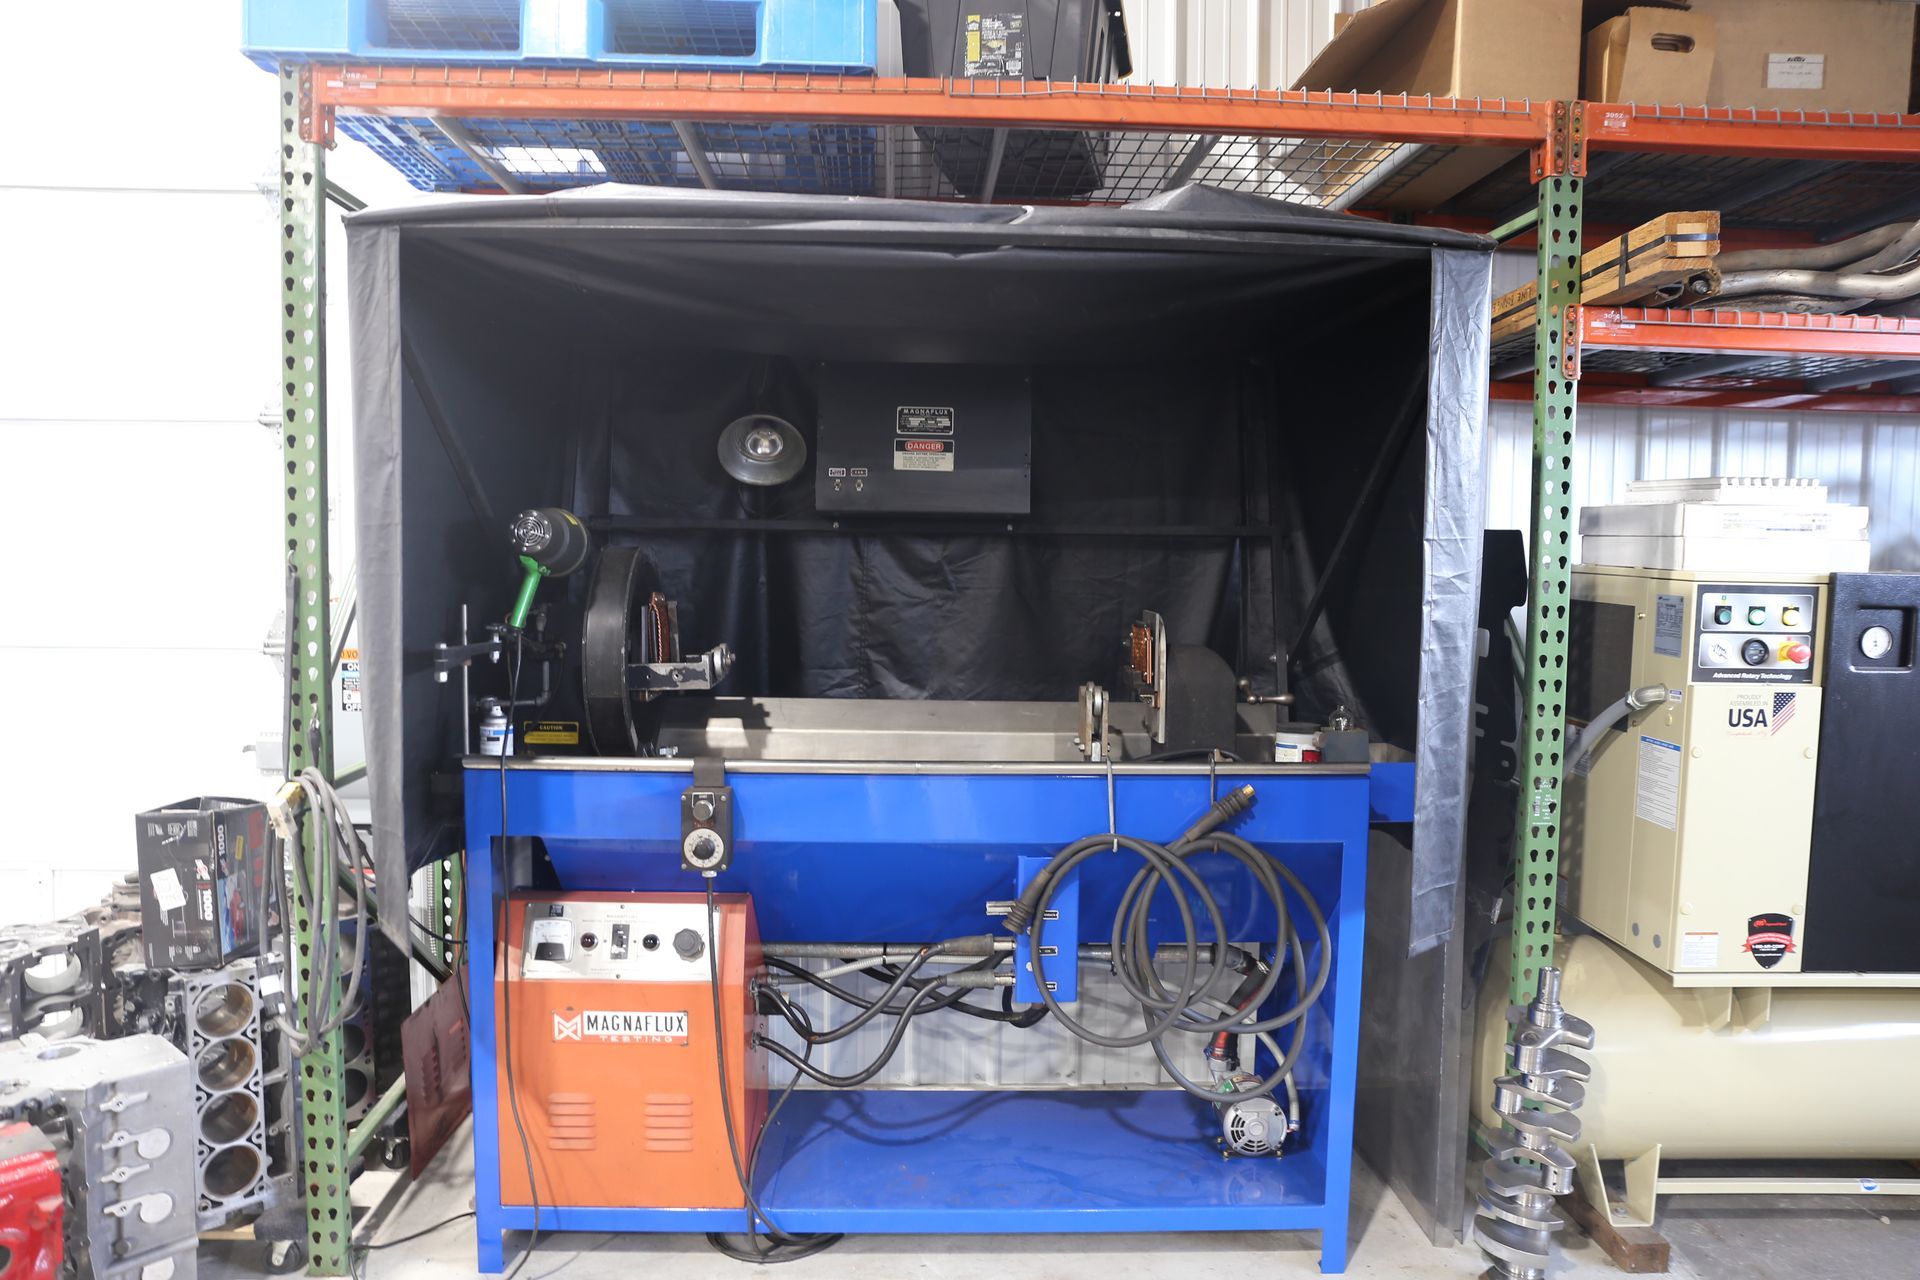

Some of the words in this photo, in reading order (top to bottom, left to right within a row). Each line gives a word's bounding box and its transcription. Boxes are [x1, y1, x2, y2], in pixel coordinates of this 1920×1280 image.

[347, 663, 359, 671] ON
[1761, 673, 1792, 681] Technology
[1728, 708, 1768, 728] USA
[217, 824, 226, 857] 1000
[202, 887, 213, 921] 1000
[587, 1014, 684, 1033] MAGNAFLUX
[600, 1034, 673, 1043] TESTING
